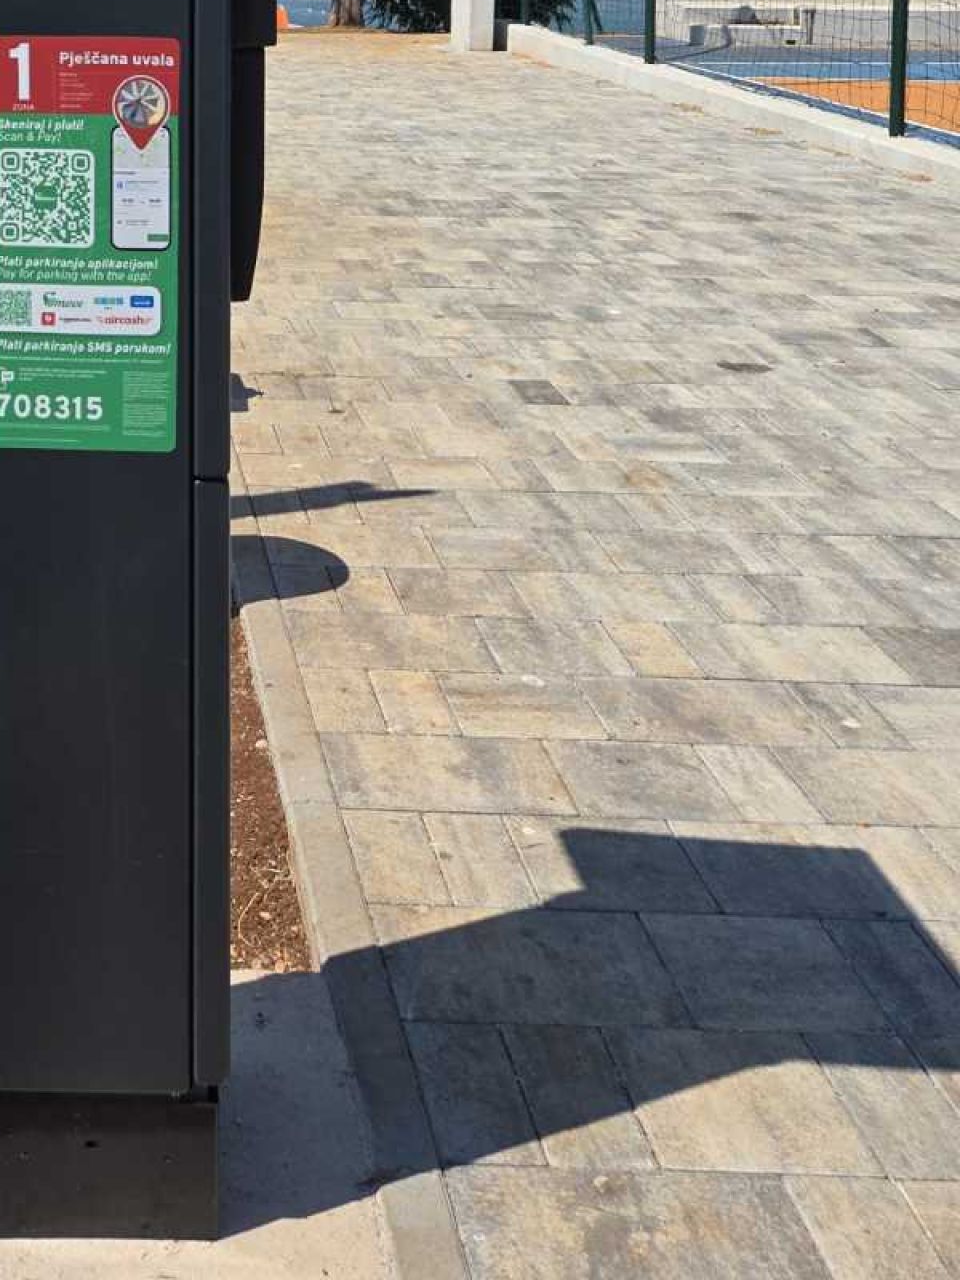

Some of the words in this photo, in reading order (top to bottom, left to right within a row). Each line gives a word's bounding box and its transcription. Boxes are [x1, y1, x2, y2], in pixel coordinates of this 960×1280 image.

[59, 51, 128, 68] Pješčana
[132, 52, 175, 67] uvala
[8, 42, 30, 102] 1
[28, 257, 85, 270] parkiranje
[36, 269, 79, 282] parking
[24, 339, 84, 354] parkiranje
[87, 342, 113, 353] SMS
